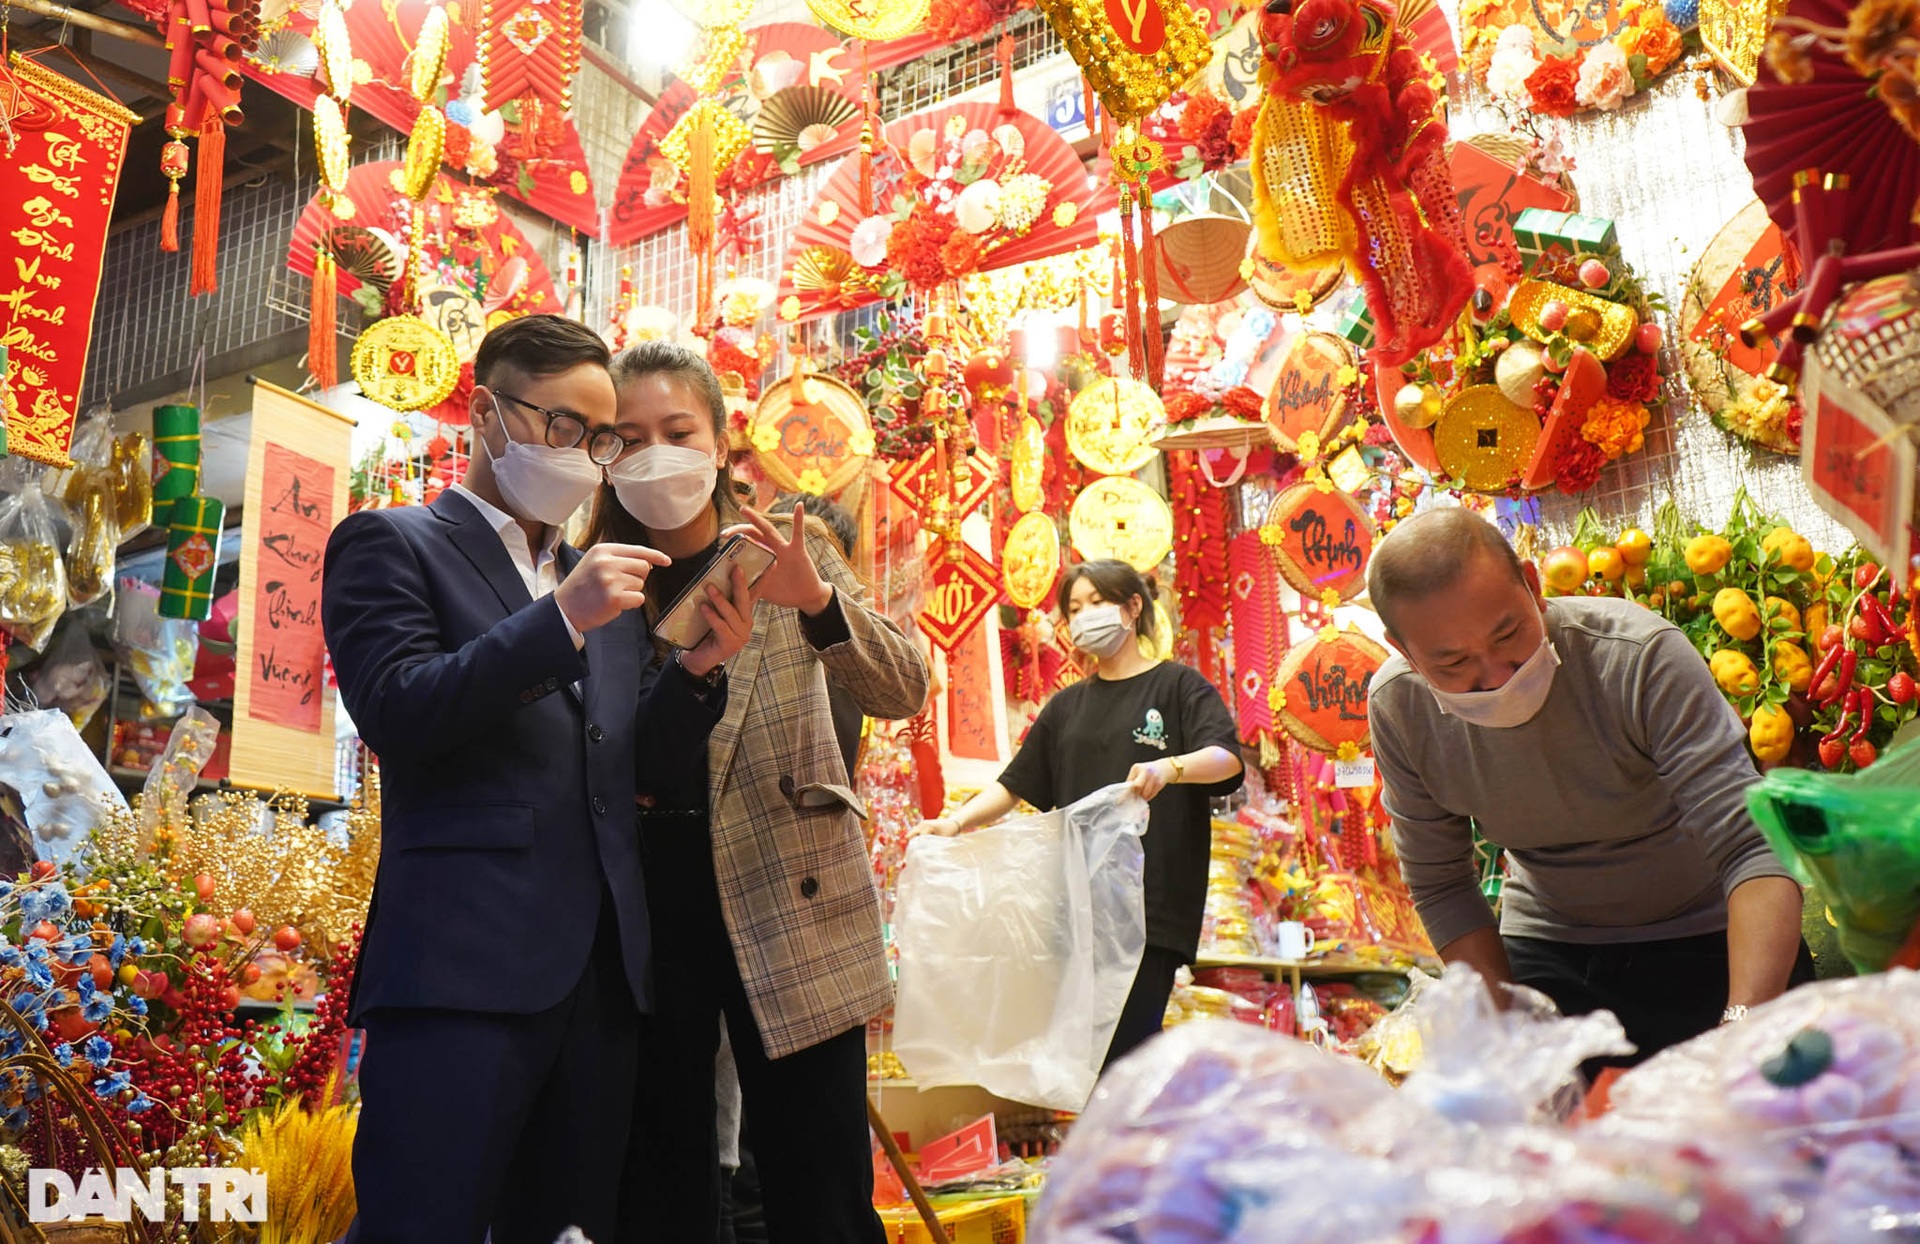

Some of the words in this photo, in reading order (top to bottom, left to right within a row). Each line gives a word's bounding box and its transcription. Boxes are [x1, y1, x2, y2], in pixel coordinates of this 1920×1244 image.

[43, 132, 88, 171] Tết
[19, 163, 81, 198] Đến
[23, 196, 73, 228] Gia
[11, 227, 74, 262] Đình
[15, 256, 62, 290] Vui
[0, 285, 66, 326] Hạnh
[0, 321, 58, 361] Phúc
[270, 475, 320, 520] An
[263, 530, 322, 582] Khang
[265, 581, 316, 629] Thịnh
[924, 571, 974, 625] MỚI
[260, 646, 314, 705] Vượng
